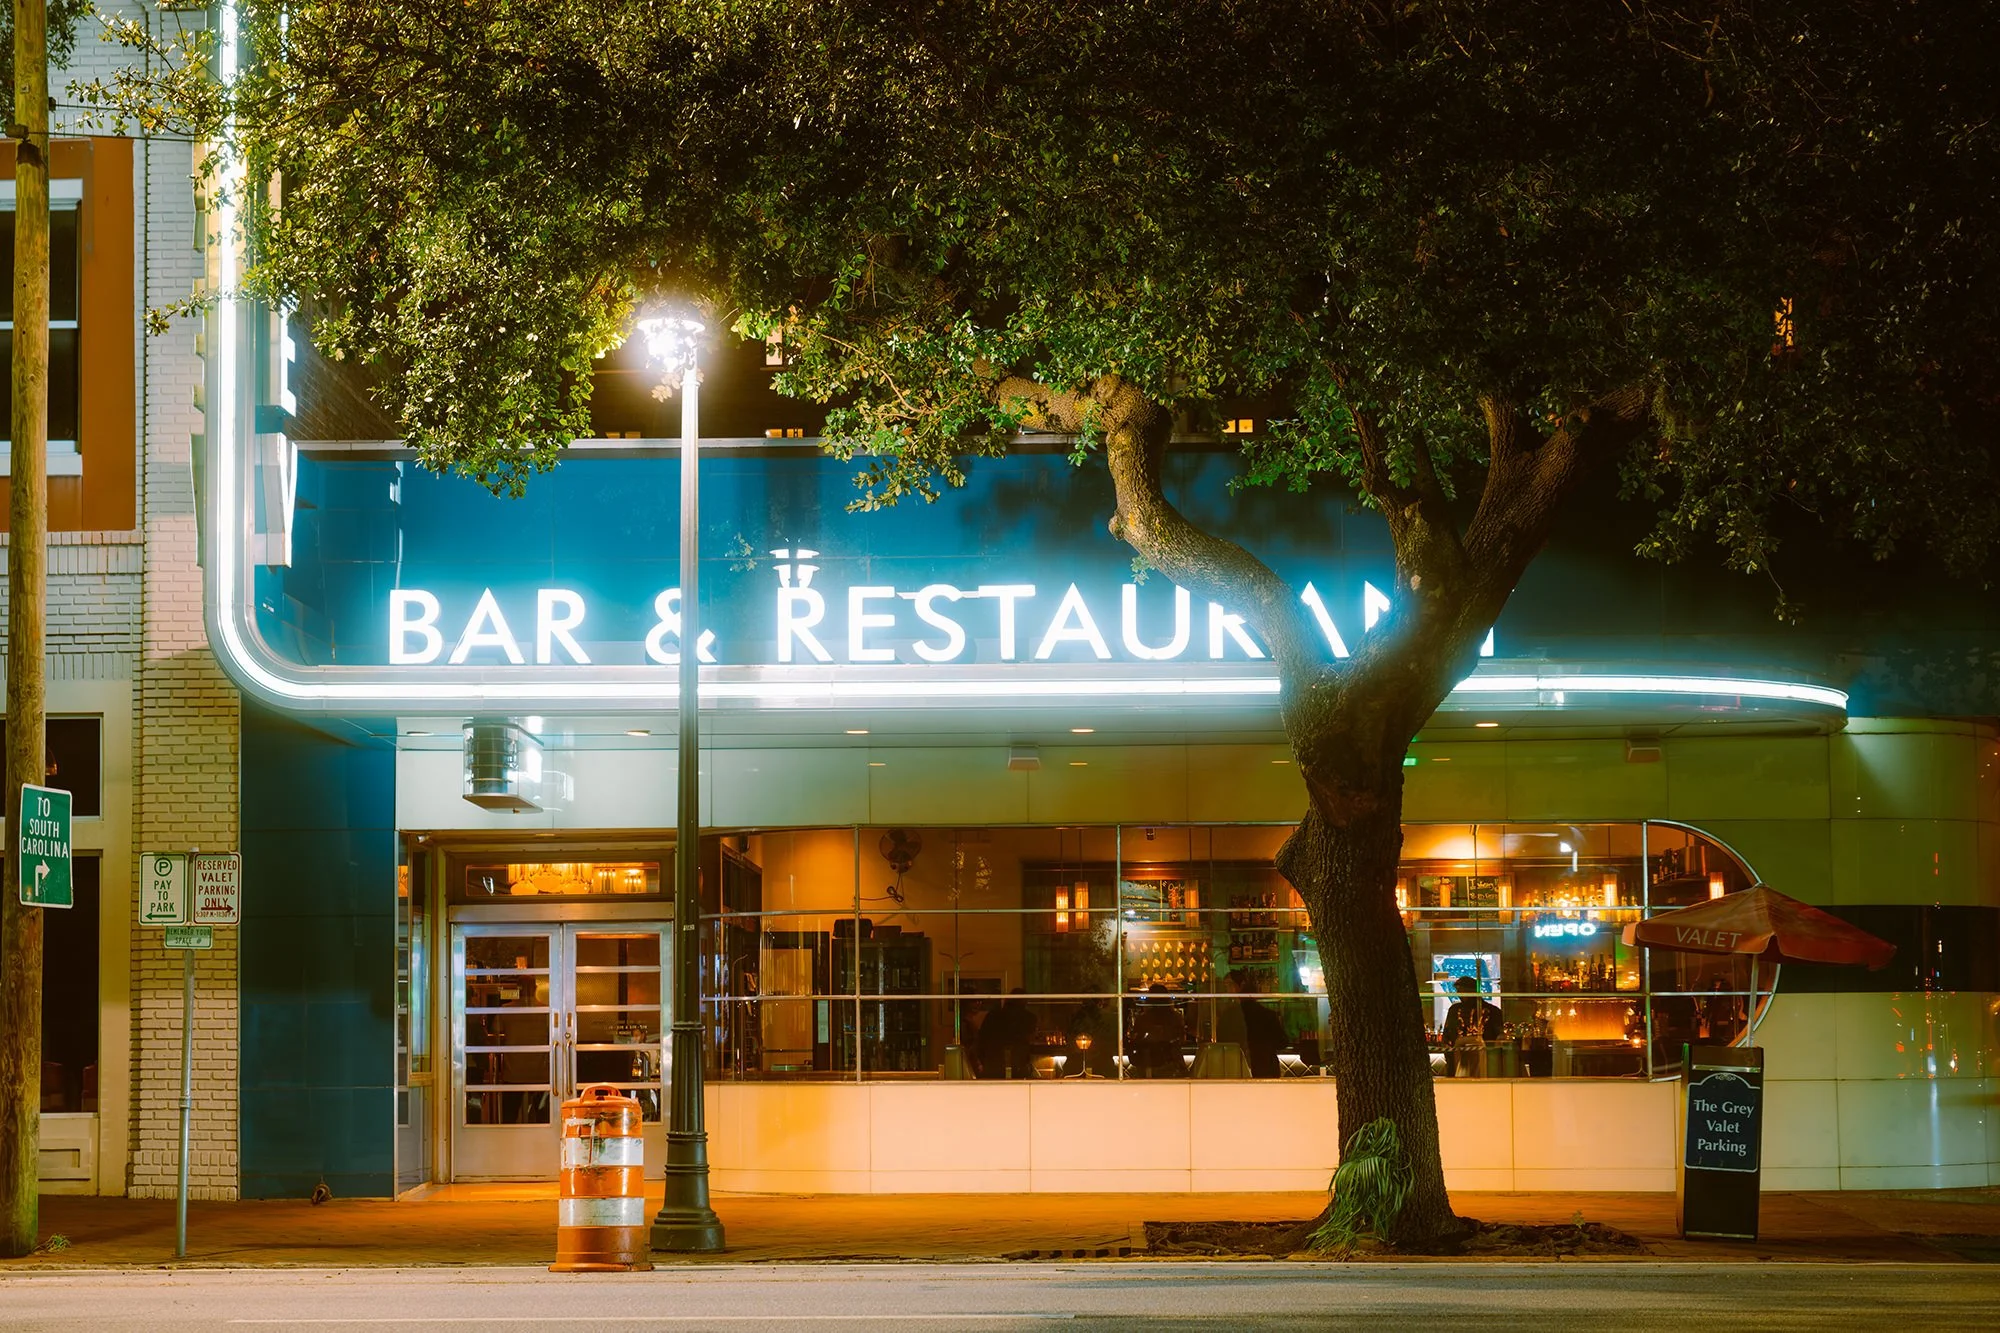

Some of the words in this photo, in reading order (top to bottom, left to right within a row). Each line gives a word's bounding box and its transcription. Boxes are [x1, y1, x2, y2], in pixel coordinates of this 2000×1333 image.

[388, 587, 593, 665] BAR
[644, 587, 718, 665] &
[777, 580, 1496, 663] RESTAUR
[37, 796, 51, 817] TO
[29, 818, 60, 838] SOUTH
[21, 836, 69, 859] CAROLINA
[197, 860, 237, 870] RESERVED
[201, 872, 233, 882] VALET
[154, 880, 172, 890] PAY
[198, 885, 235, 895] PARKING
[158, 891, 168, 900] TO
[204, 897, 229, 908] ONLY
[150, 902, 175, 912] PARK
[1675, 926, 1742, 948] VALET
[1693, 1099, 1718, 1113] The
[1722, 1101, 1755, 1118] Grey
[1706, 1119, 1740, 1133] Valet
[1697, 1138, 1747, 1157] Parking
